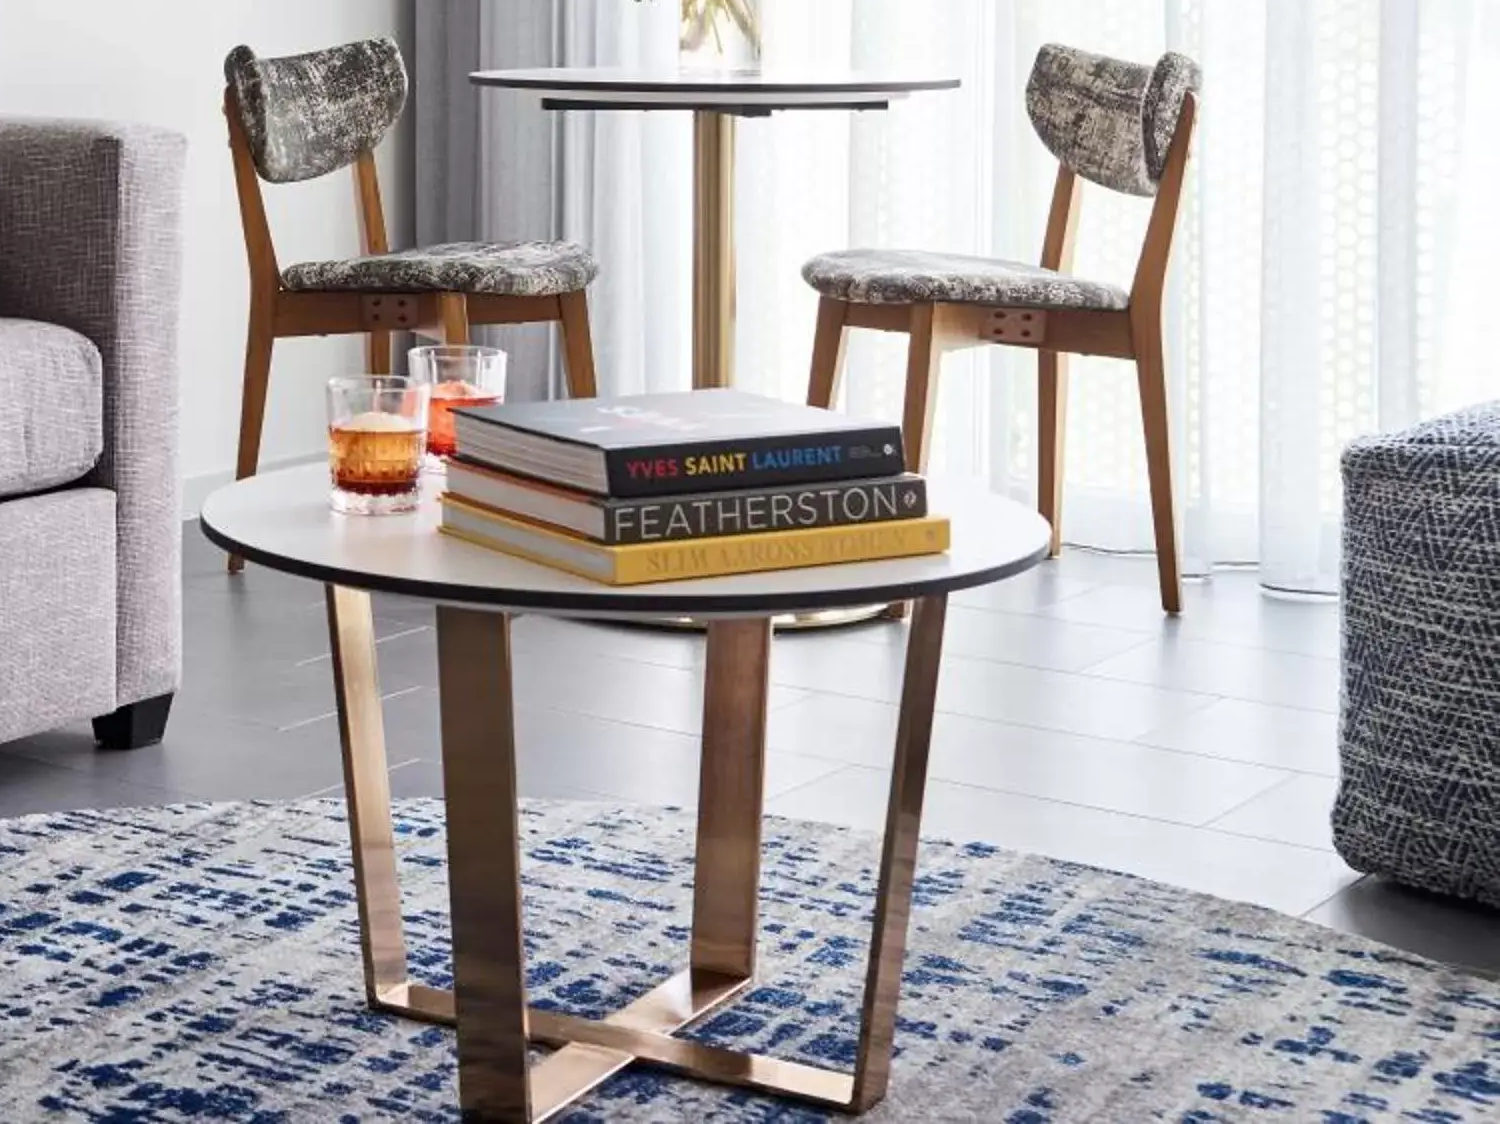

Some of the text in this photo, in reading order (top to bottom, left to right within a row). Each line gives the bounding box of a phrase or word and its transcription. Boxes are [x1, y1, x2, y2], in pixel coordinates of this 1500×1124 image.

[627, 458, 678, 477] YVES
[685, 452, 746, 475] SAINT
[753, 445, 842, 470] LAURENT
[615, 485, 897, 541] FEATHERSTON
